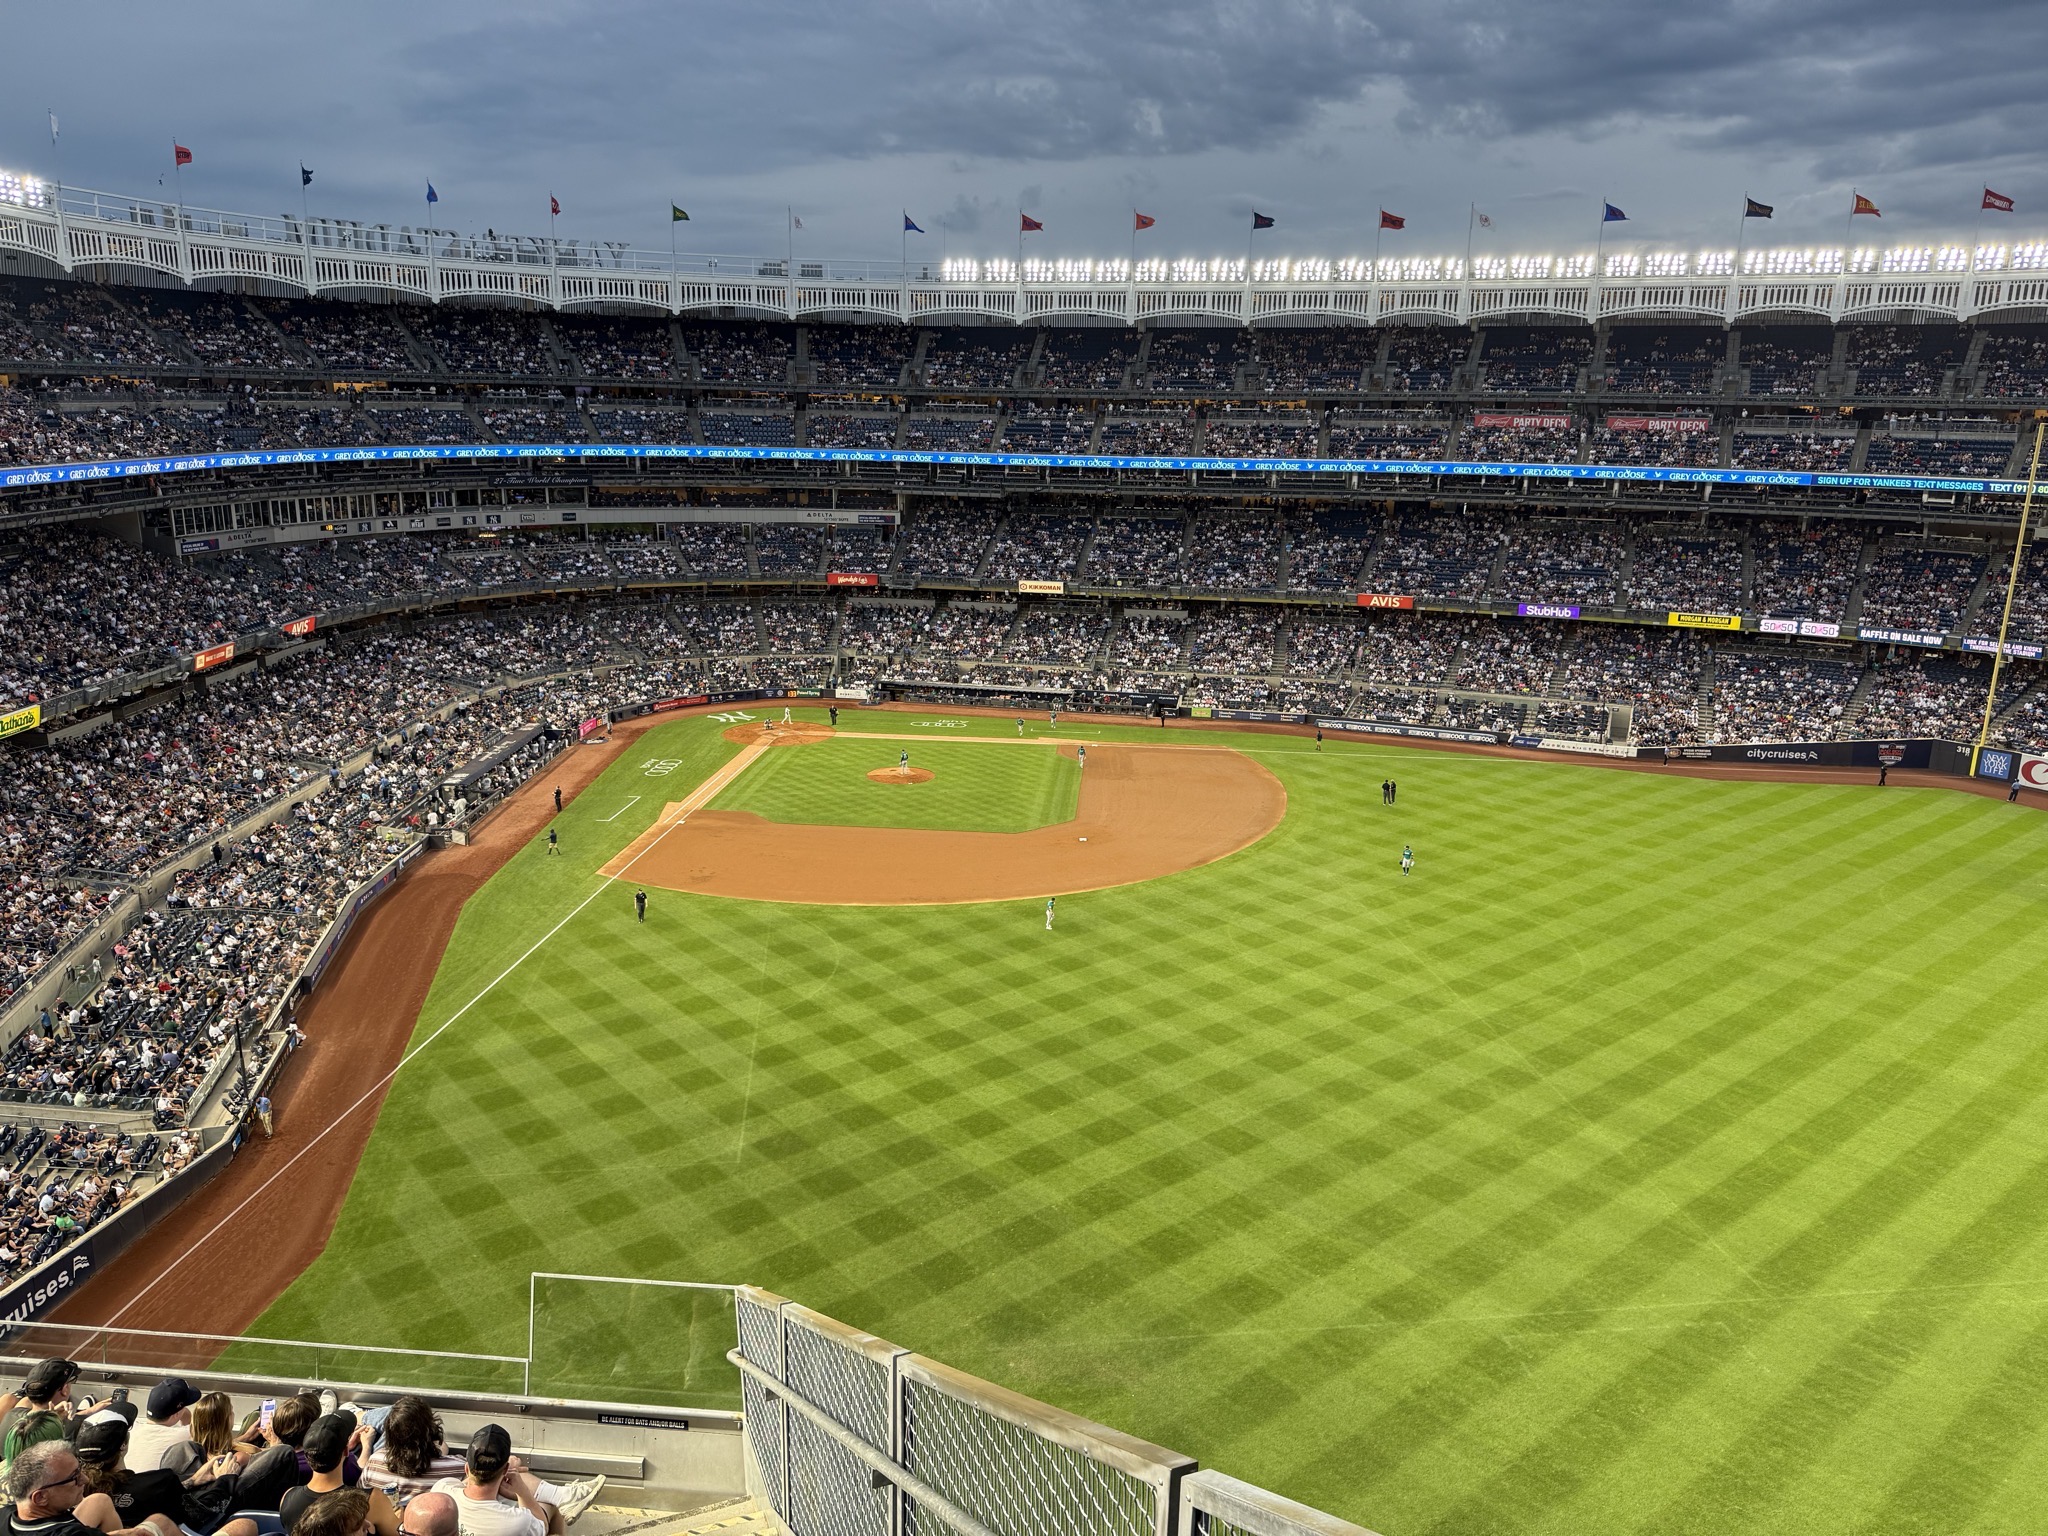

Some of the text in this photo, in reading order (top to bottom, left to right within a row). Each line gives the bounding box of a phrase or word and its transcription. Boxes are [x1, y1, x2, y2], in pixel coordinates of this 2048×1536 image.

[1513, 417, 1541, 427] PARTY
[1543, 418, 1567, 427] DECK
[1648, 420, 1678, 430] PARTY
[1680, 420, 1706, 430] DECK
[335, 450, 376, 460] GREY GOOSE
[412, 448, 438, 458] GOOSE
[475, 447, 499, 457] GOOSE
[538, 447, 563, 456] GOOSE
[601, 447, 626, 456] GOOSE
[665, 447, 689, 457] GOOSE
[728, 449, 751, 457] GOOSE
[790, 450, 814, 459] GOOSE
[850, 451, 874, 460] GOOSE
[221, 454, 261, 466] GREY GOOSE
[277, 452, 316, 463] GREY GOOSE
[910, 453, 933, 462] GOOSE
[968, 455, 991, 464] GOOSE
[1028, 457, 1050, 465] GOOSE
[1088, 458, 1112, 467] GOOSE
[126, 462, 161, 474] GREY GOOSE
[174, 458, 207, 469] GREY GOOSE
[1148, 459, 1173, 468] GOOSE
[1210, 460, 1235, 469] GOOSE
[1275, 462, 1299, 470] GOOSE
[1339, 463, 1366, 472] GOOSE
[1406, 464, 1433, 473] GOOSE
[70, 466, 110, 480] GREY GOOSE
[1474, 465, 1502, 475] GOOSE
[1523, 467, 1573, 477] GREY GOOSE
[1595, 469, 1647, 479] GREY GOOSE
[7, 470, 52, 485] GREY GOOSE
[1669, 471, 1724, 481] GREY GOOSE
[1745, 474, 1802, 484] GREY GOOSE
[551, 477, 589, 486] Champions
[1817, 476, 1984, 491] SIGN UP FOR YANKEES TEXT MESSAGES
[1989, 483, 2012, 492] TEXT
[2013, 483, 2037, 493] (91)
[837, 575, 858, 584] Wendy's
[1370, 596, 1401, 607] AVIS
[1526, 605, 1571, 617] StubHub
[292, 620, 309, 633] AVIS
[1860, 629, 1942, 645] RAFFLE ON SALE NOW
[2012, 649, 2036, 657] STADIUM
[1747, 748, 1807, 760] citycruises
[1956, 746, 1971, 754] 318
[1986, 753, 2008, 762] NEW
[1983, 759, 2007, 770] YORK
[1984, 766, 2004, 775] LIFE
[609, 1416, 624, 1424] ALERT
[635, 1418, 648, 1426] BATS
[668, 1421, 685, 1429] BALLS
